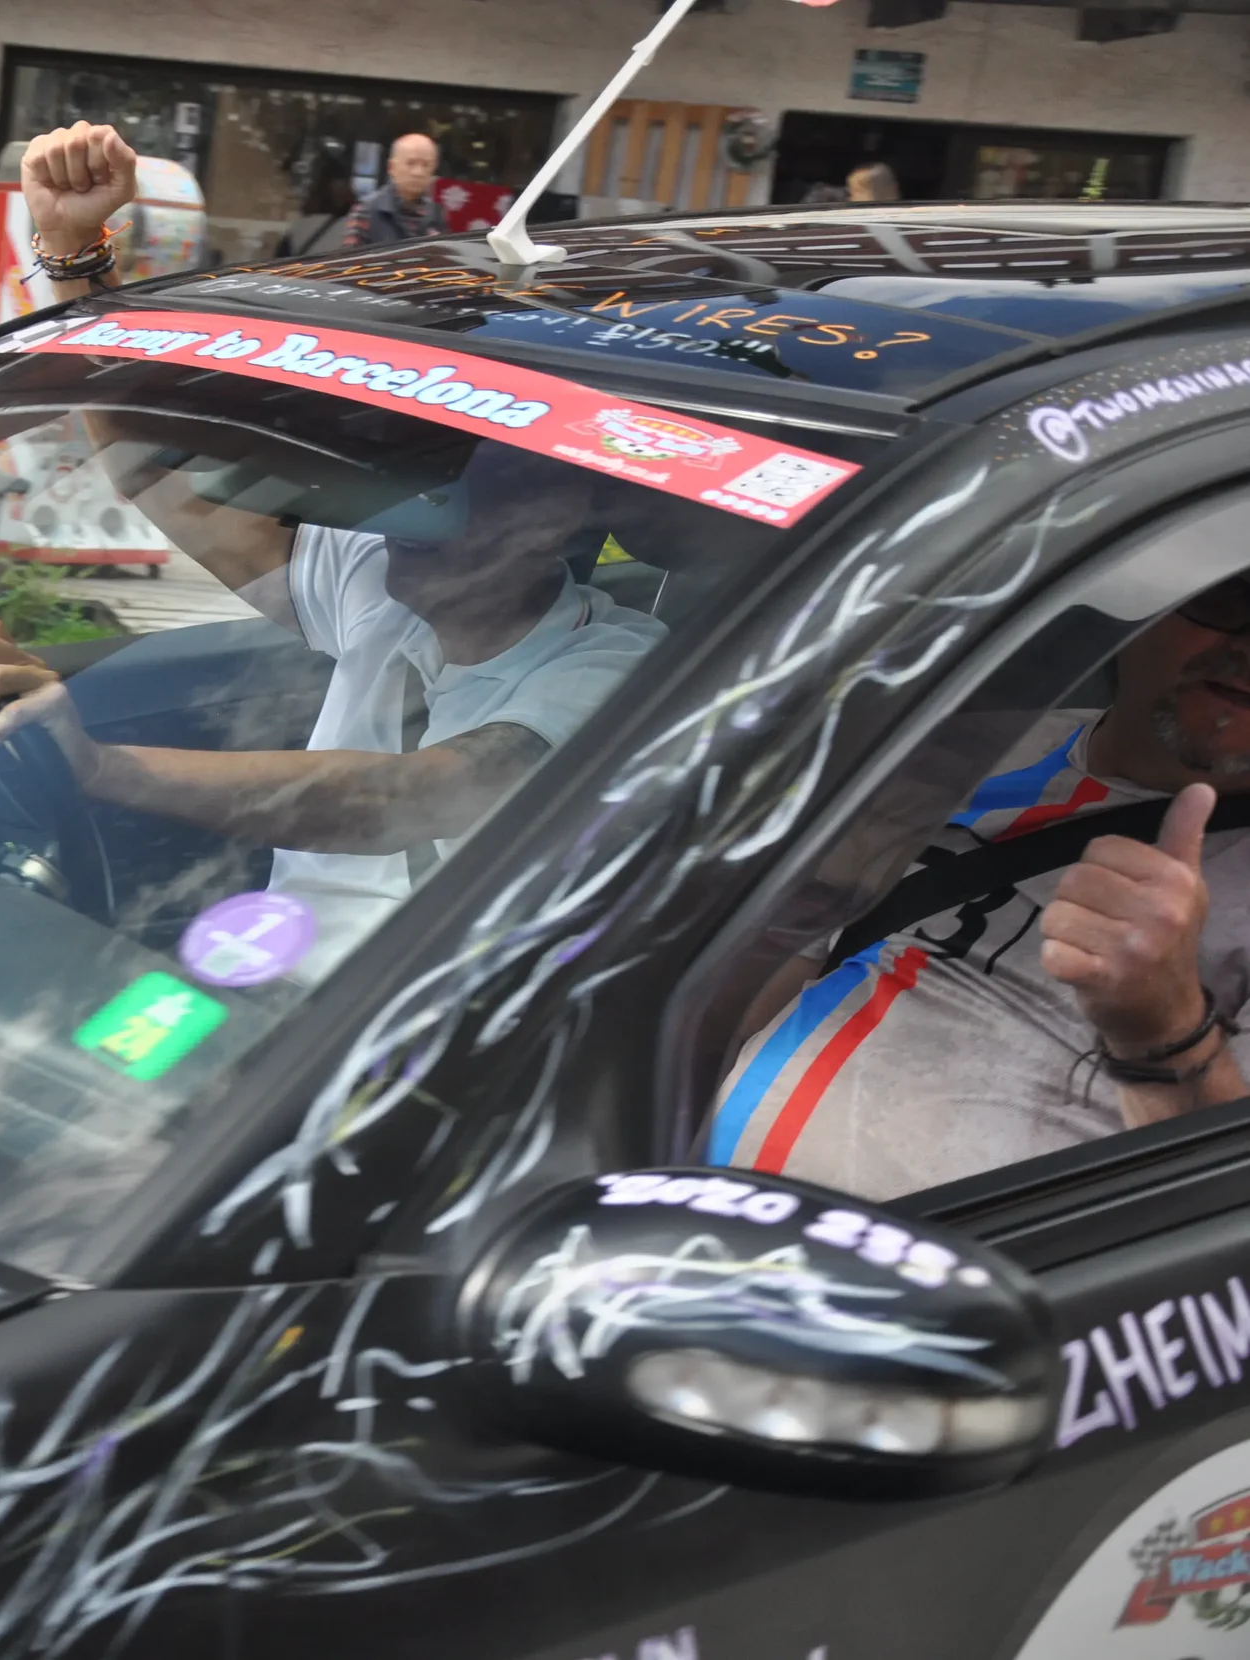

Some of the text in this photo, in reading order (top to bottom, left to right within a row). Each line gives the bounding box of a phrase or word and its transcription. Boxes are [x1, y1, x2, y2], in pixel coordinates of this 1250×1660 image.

[60, 320, 552, 429] Barmy to Barcelona
